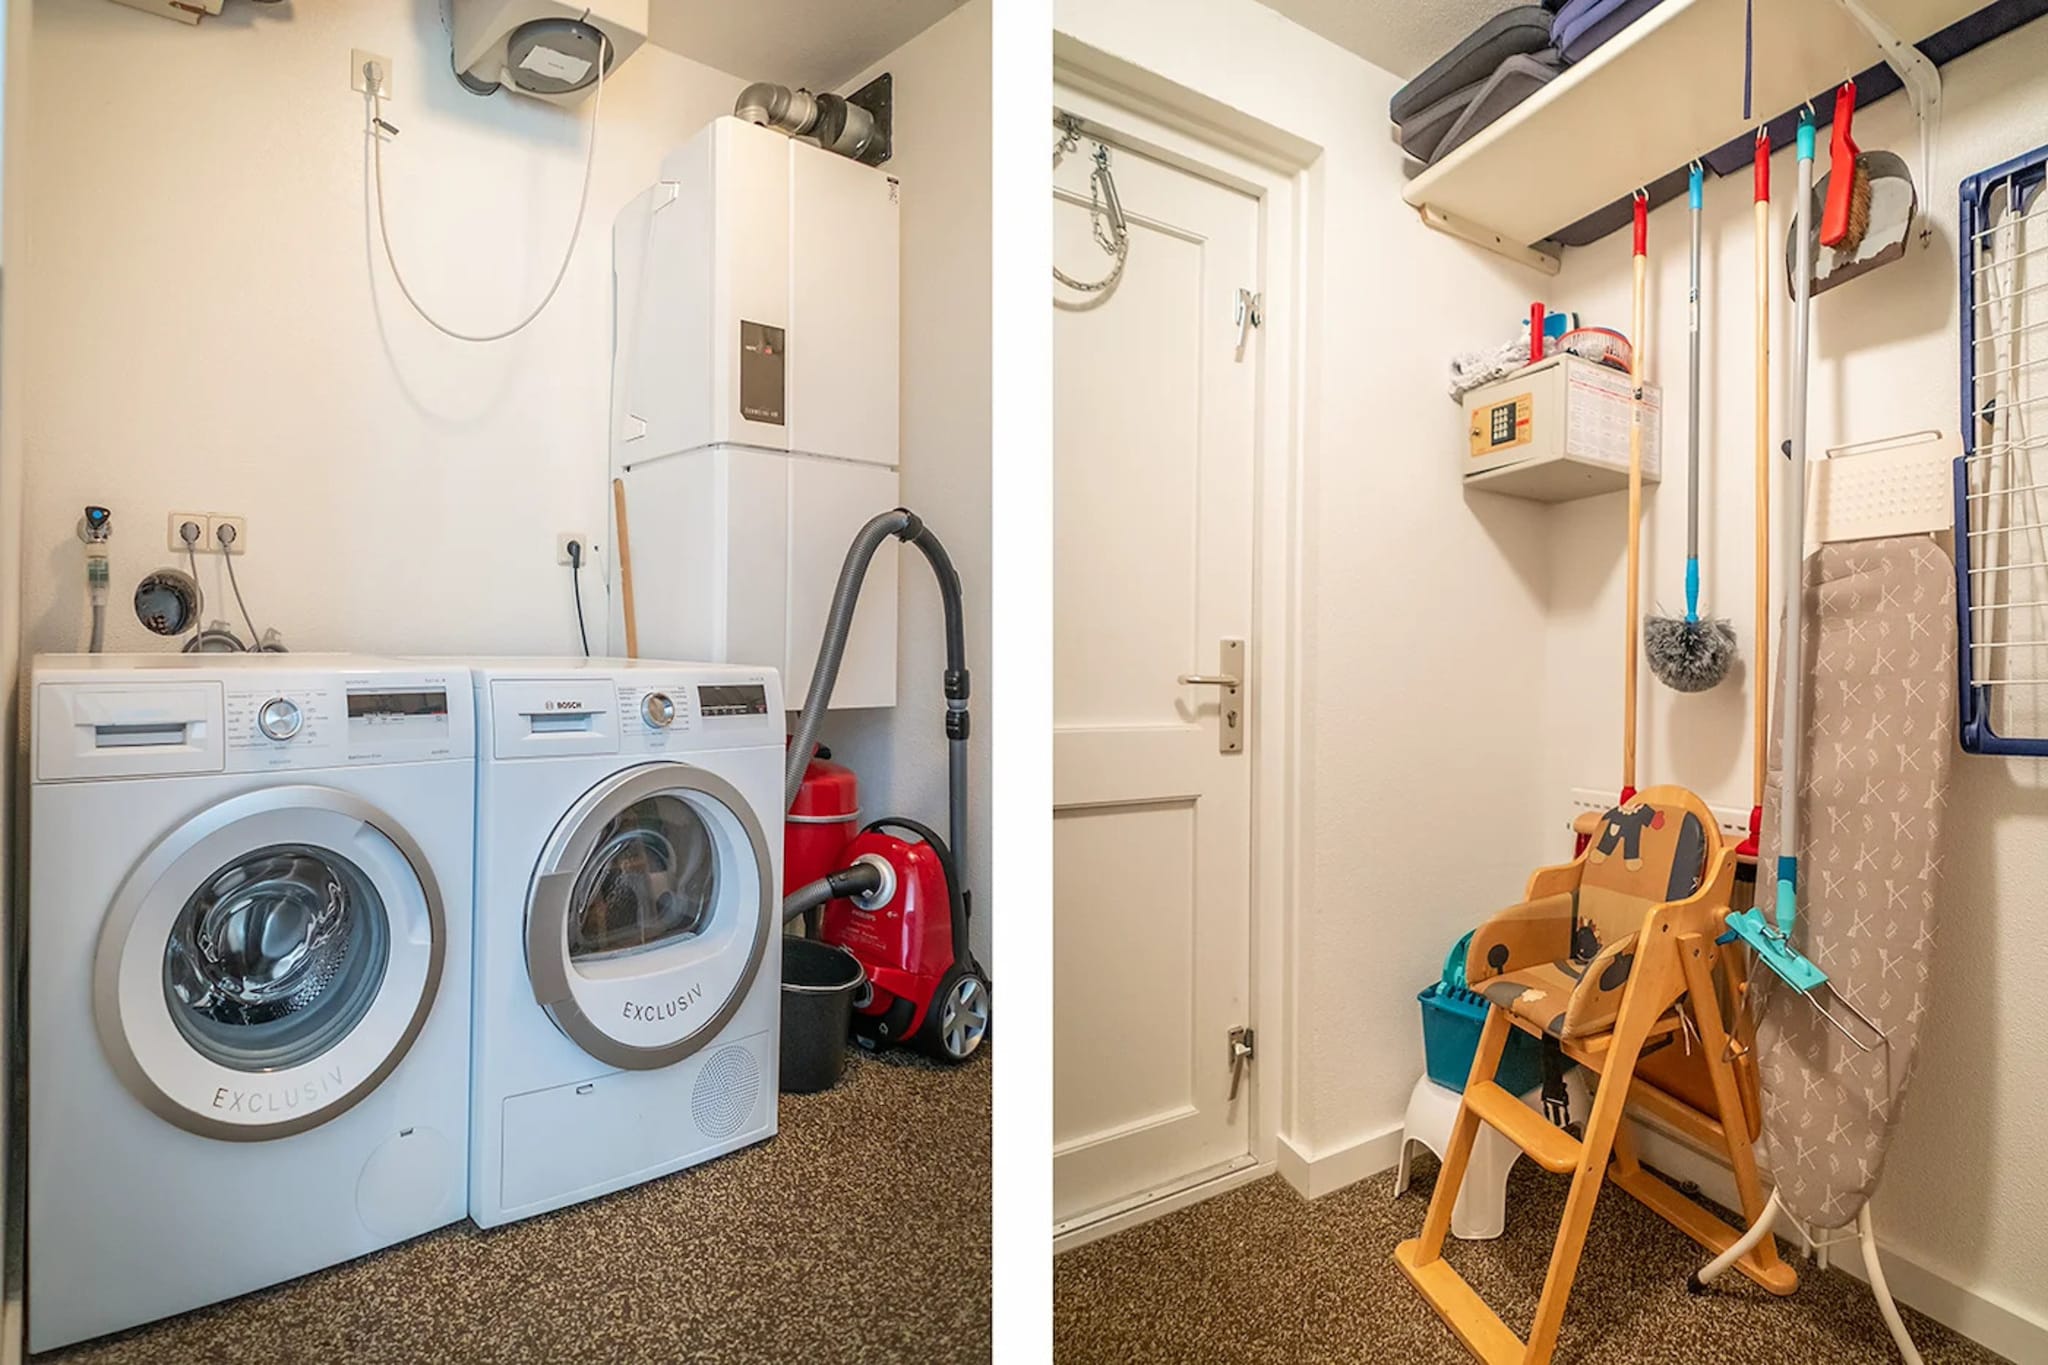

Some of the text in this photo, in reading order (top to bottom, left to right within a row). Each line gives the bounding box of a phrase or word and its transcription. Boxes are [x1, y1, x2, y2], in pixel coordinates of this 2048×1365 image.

[557, 701, 582, 709] BOSCH
[622, 983, 702, 1021] EXCLUSIV
[212, 1065, 343, 1113] EXCLUSIV
